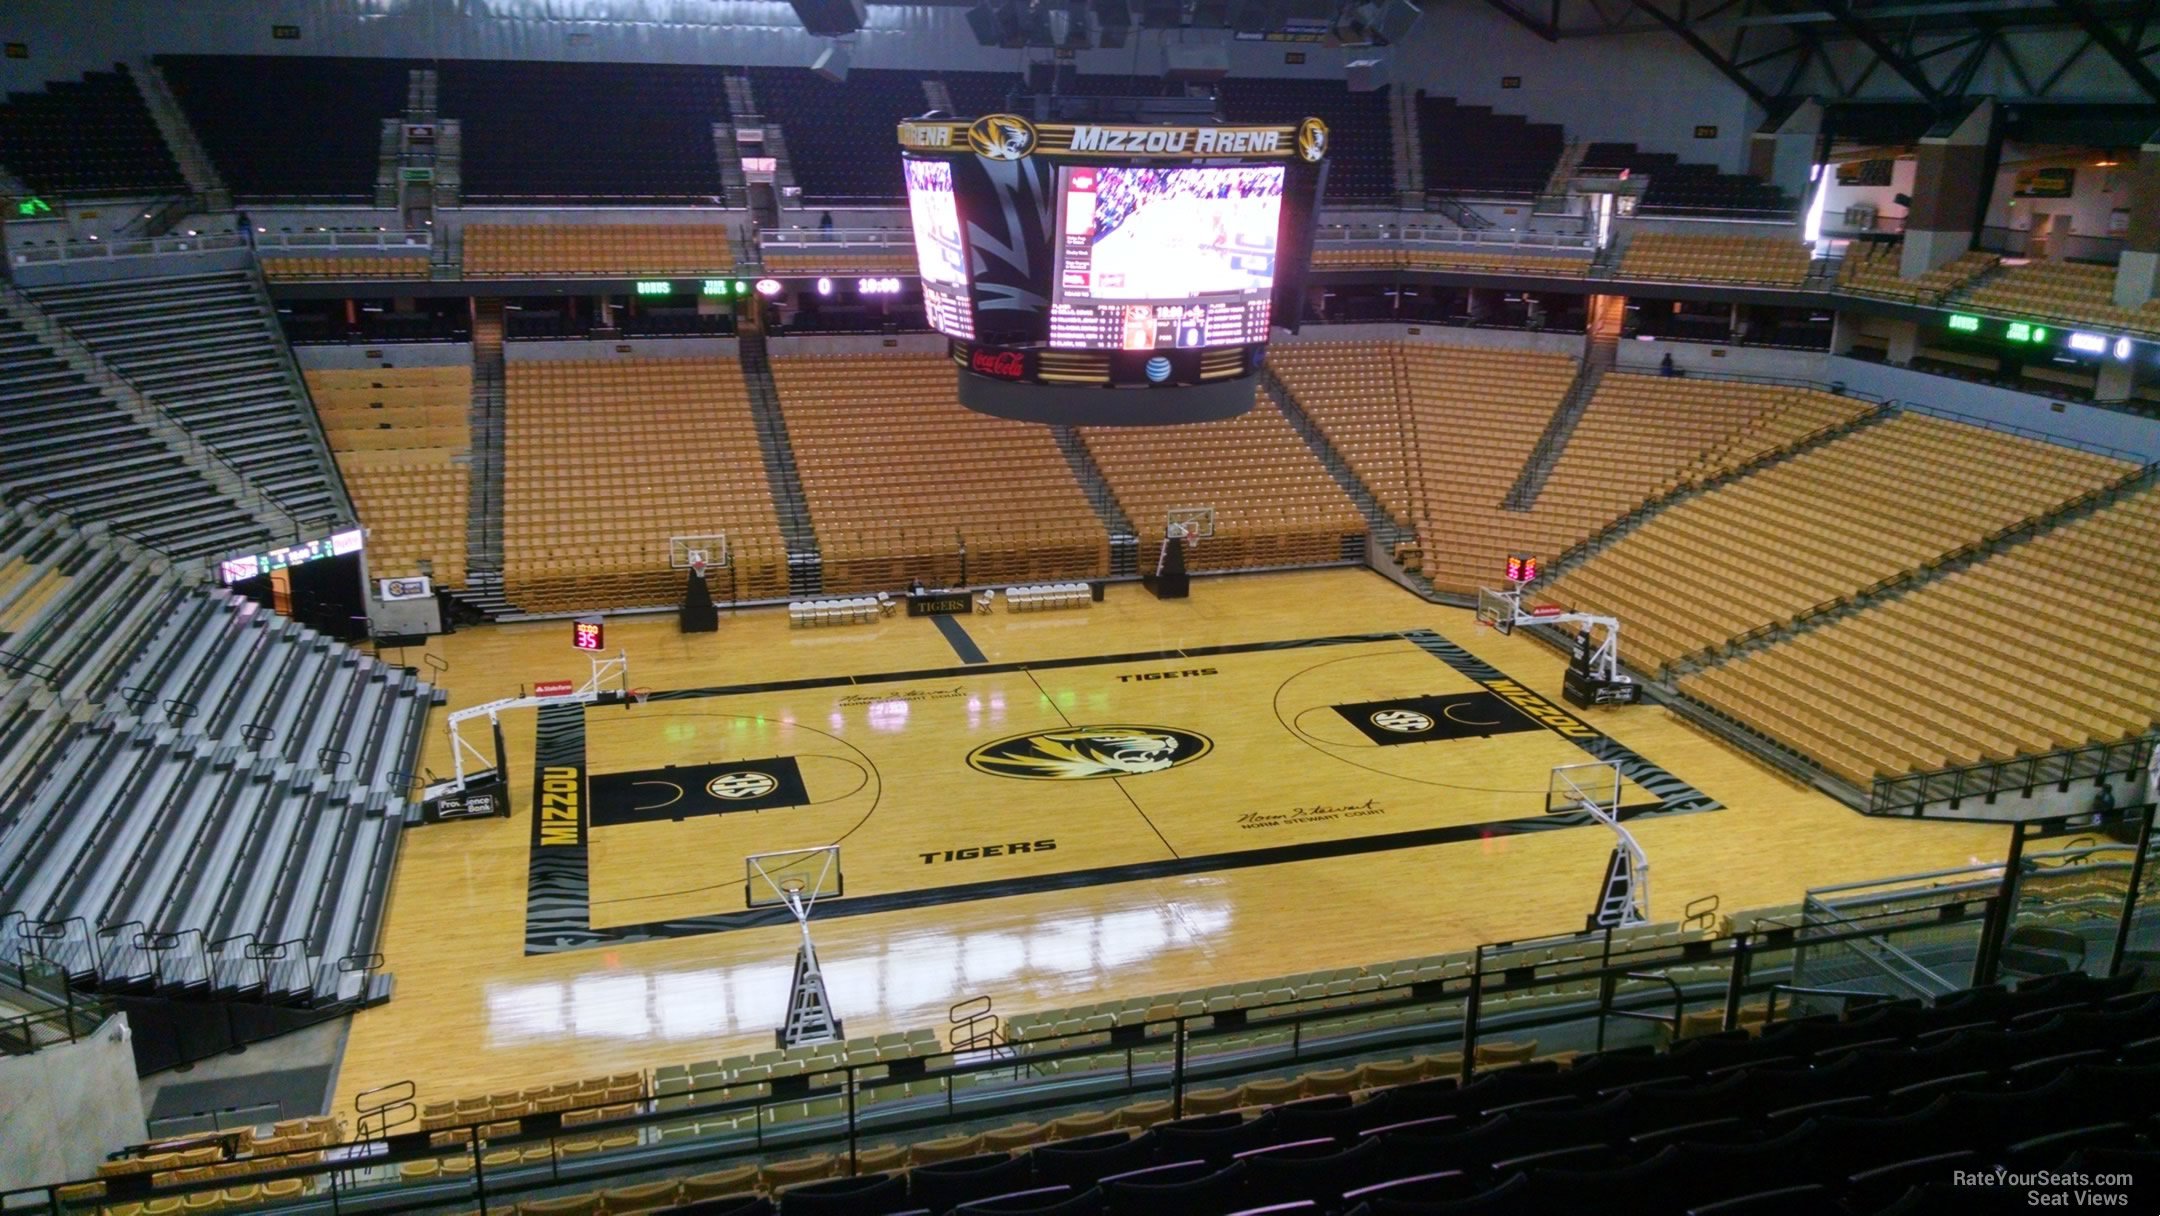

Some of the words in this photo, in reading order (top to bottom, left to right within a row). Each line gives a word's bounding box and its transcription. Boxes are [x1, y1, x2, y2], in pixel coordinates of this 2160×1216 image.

[1071, 126, 1188, 153] MIZZOU
[1194, 127, 1279, 153] ARENA
[637, 282, 670, 294] BONUS
[818, 278, 831, 294] 0
[918, 600, 964, 613] TIGERS
[577, 632, 596, 648] 35
[1116, 667, 1218, 683] TIGERS
[1482, 680, 1600, 737] MIZZOU
[1375, 711, 1430, 733] SEC
[711, 773, 774, 798] SEC
[468, 803, 491, 813] Bank
[541, 767, 578, 846] MIZZOU
[1241, 820, 1279, 830] NORM
[1283, 813, 1340, 825] STEWART
[1344, 808, 1385, 818] COURT
[919, 839, 1057, 865] TIGERS
